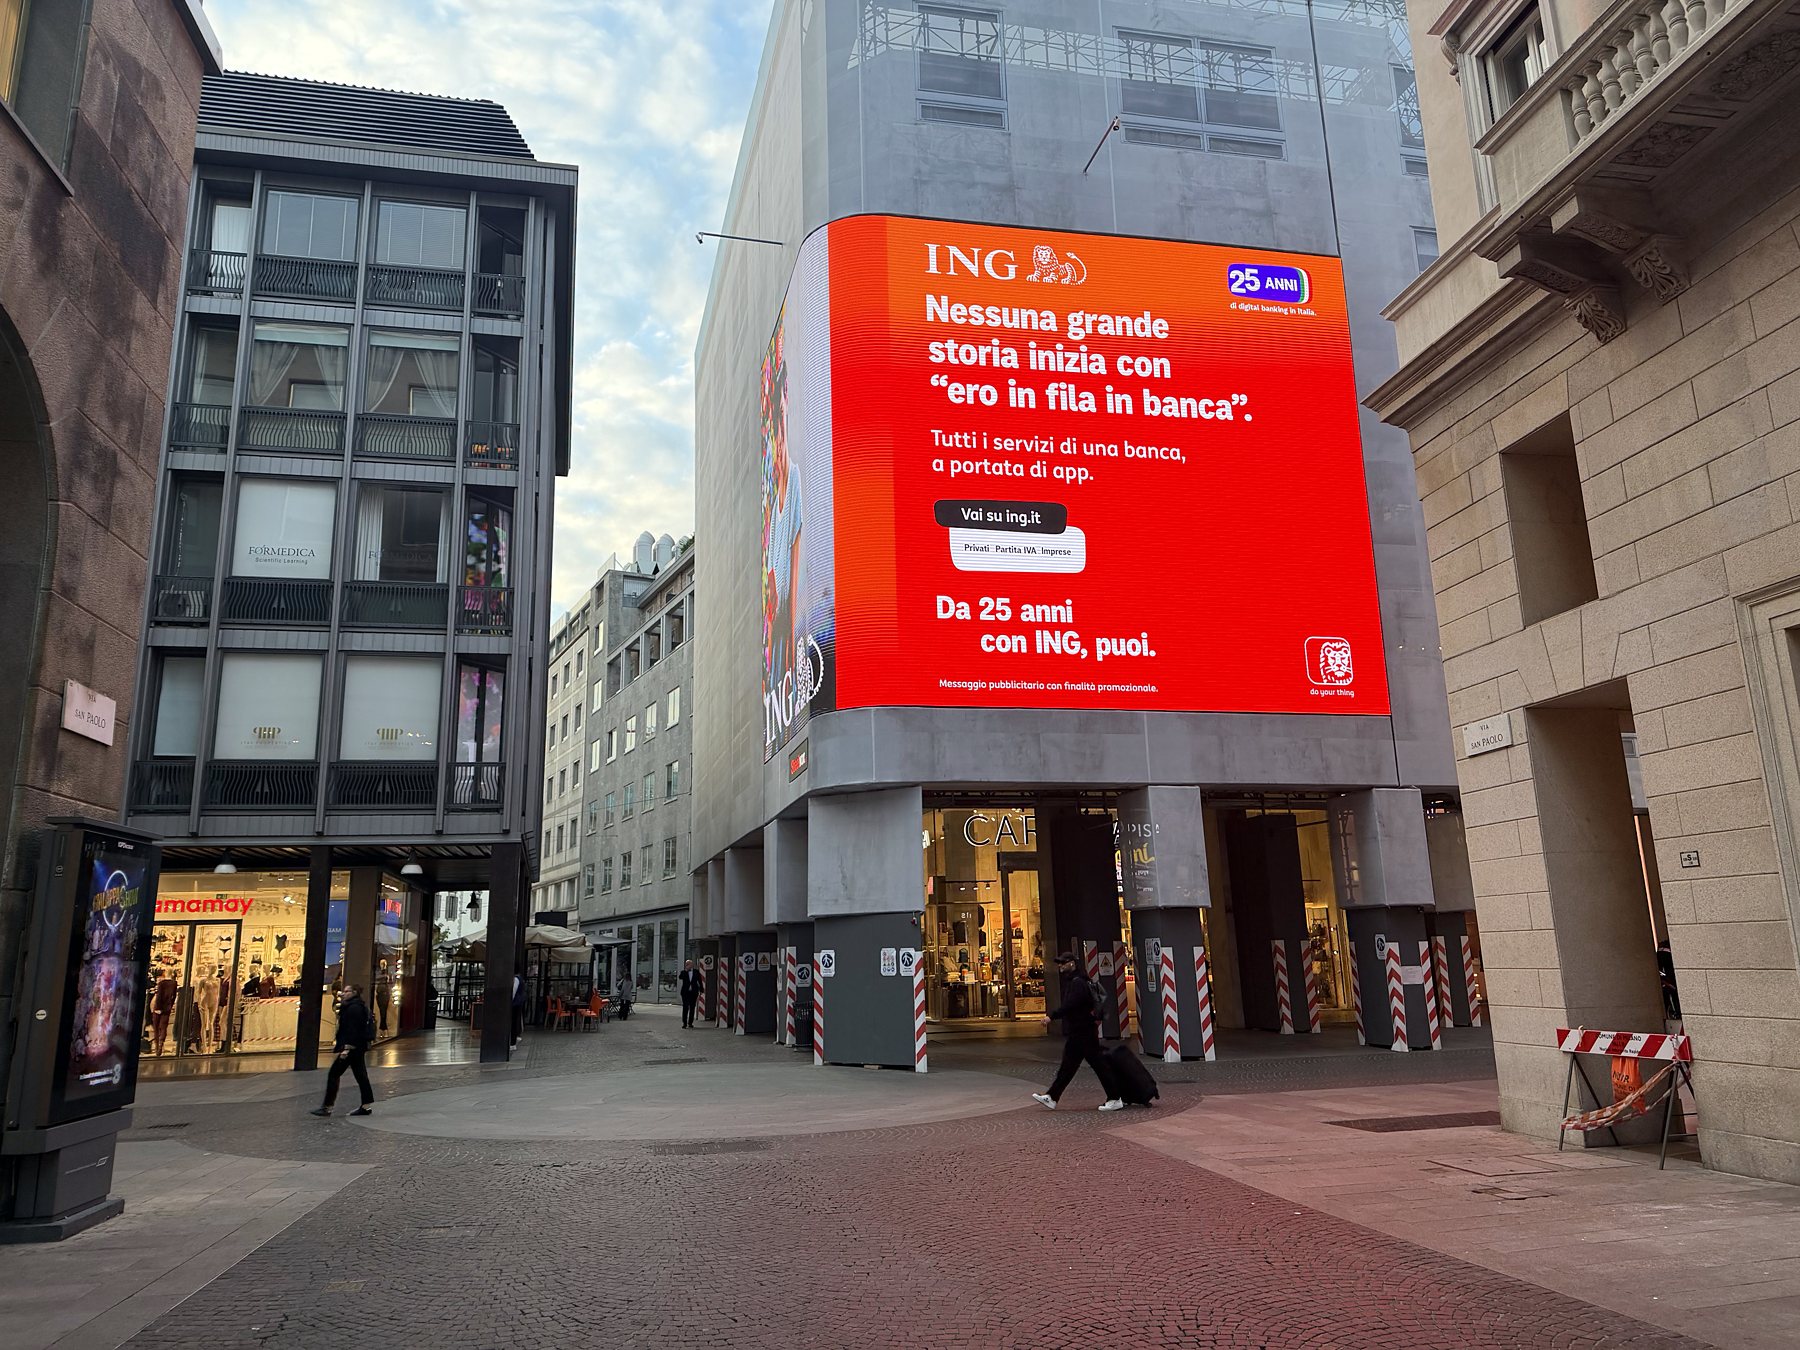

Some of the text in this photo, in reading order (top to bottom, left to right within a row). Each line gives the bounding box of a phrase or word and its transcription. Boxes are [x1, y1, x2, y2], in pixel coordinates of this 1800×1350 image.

[925, 244, 1018, 280] ING
[1229, 268, 1298, 294] 25 ANNI
[926, 294, 1169, 340] Nessuna grande
[1238, 303, 1260, 312] digital
[1261, 305, 1289, 315] banking
[1297, 308, 1317, 316] Italia.
[929, 338, 1171, 378] storia inizia con
[931, 374, 1252, 421] “ero in fila in banca”.
[931, 430, 1186, 464] Tutti i servizi di una banca,
[933, 459, 1093, 484] a portata di app.
[961, 507, 1041, 527] Vai su ing.it
[248, 544, 316, 558] FORMEDICA
[255, 556, 282, 564] Scientific
[964, 543, 1072, 557] Privati Partita IVA Imprese
[937, 596, 1073, 623] Da 25 anni
[981, 630, 1156, 661] con ING, puoi.
[939, 679, 1158, 693] Messaggio pubblicitario con finalità promozionale.
[1320, 689, 1335, 697] your
[1337, 689, 1355, 698] thing
[75, 709, 106, 729] SAN PAOLO
[764, 667, 793, 746] ING
[1471, 733, 1503, 749] SAN PAOLO
